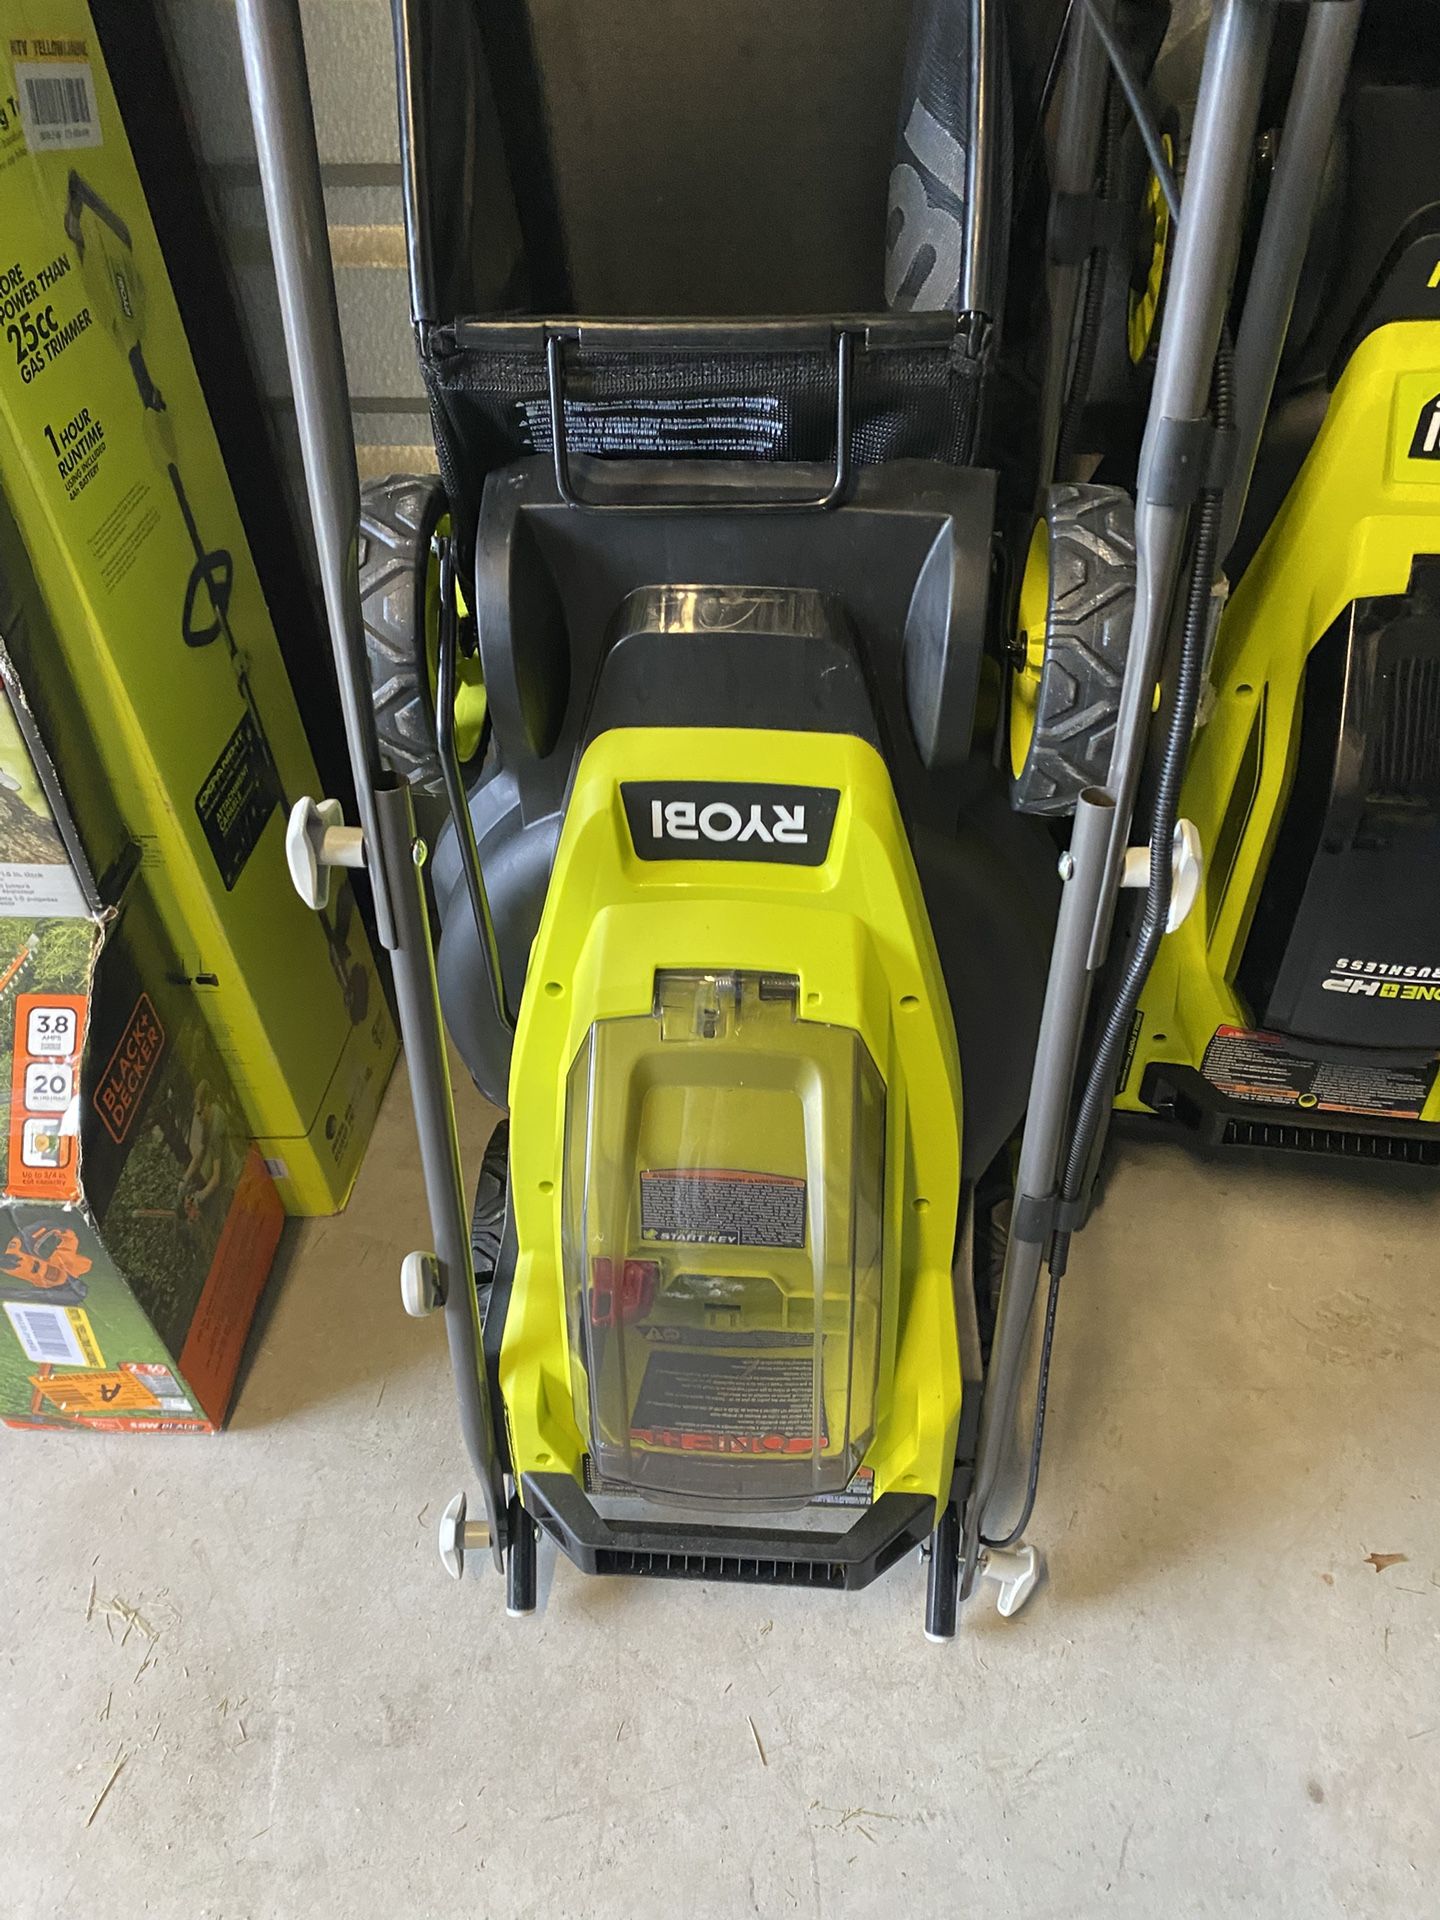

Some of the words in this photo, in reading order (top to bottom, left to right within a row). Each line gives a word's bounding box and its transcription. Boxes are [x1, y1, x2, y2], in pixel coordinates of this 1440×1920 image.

[0, 279, 40, 326] POWER
[36, 253, 71, 292] THAN
[20, 350, 46, 384] GAS
[42, 307, 93, 362] TRIMMER
[44, 413, 61, 458] 1
[59, 407, 92, 450] HOUR
[57, 419, 105, 481] RUNTIME
[65, 469, 83, 492] USING
[82, 441, 107, 474] INCLUDED
[78, 463, 101, 492] BATTERY
[651, 800, 808, 844] RYOBI
[1322, 978, 1381, 997] HP
[37, 1015, 69, 1034] 3.8
[41, 1034, 62, 1042] AMPS
[33, 1075, 67, 1095] 20
[112, 1026, 159, 1127] DECKER
[660, 1232, 706, 1242] START
[707, 1234, 737, 1244] KEY
